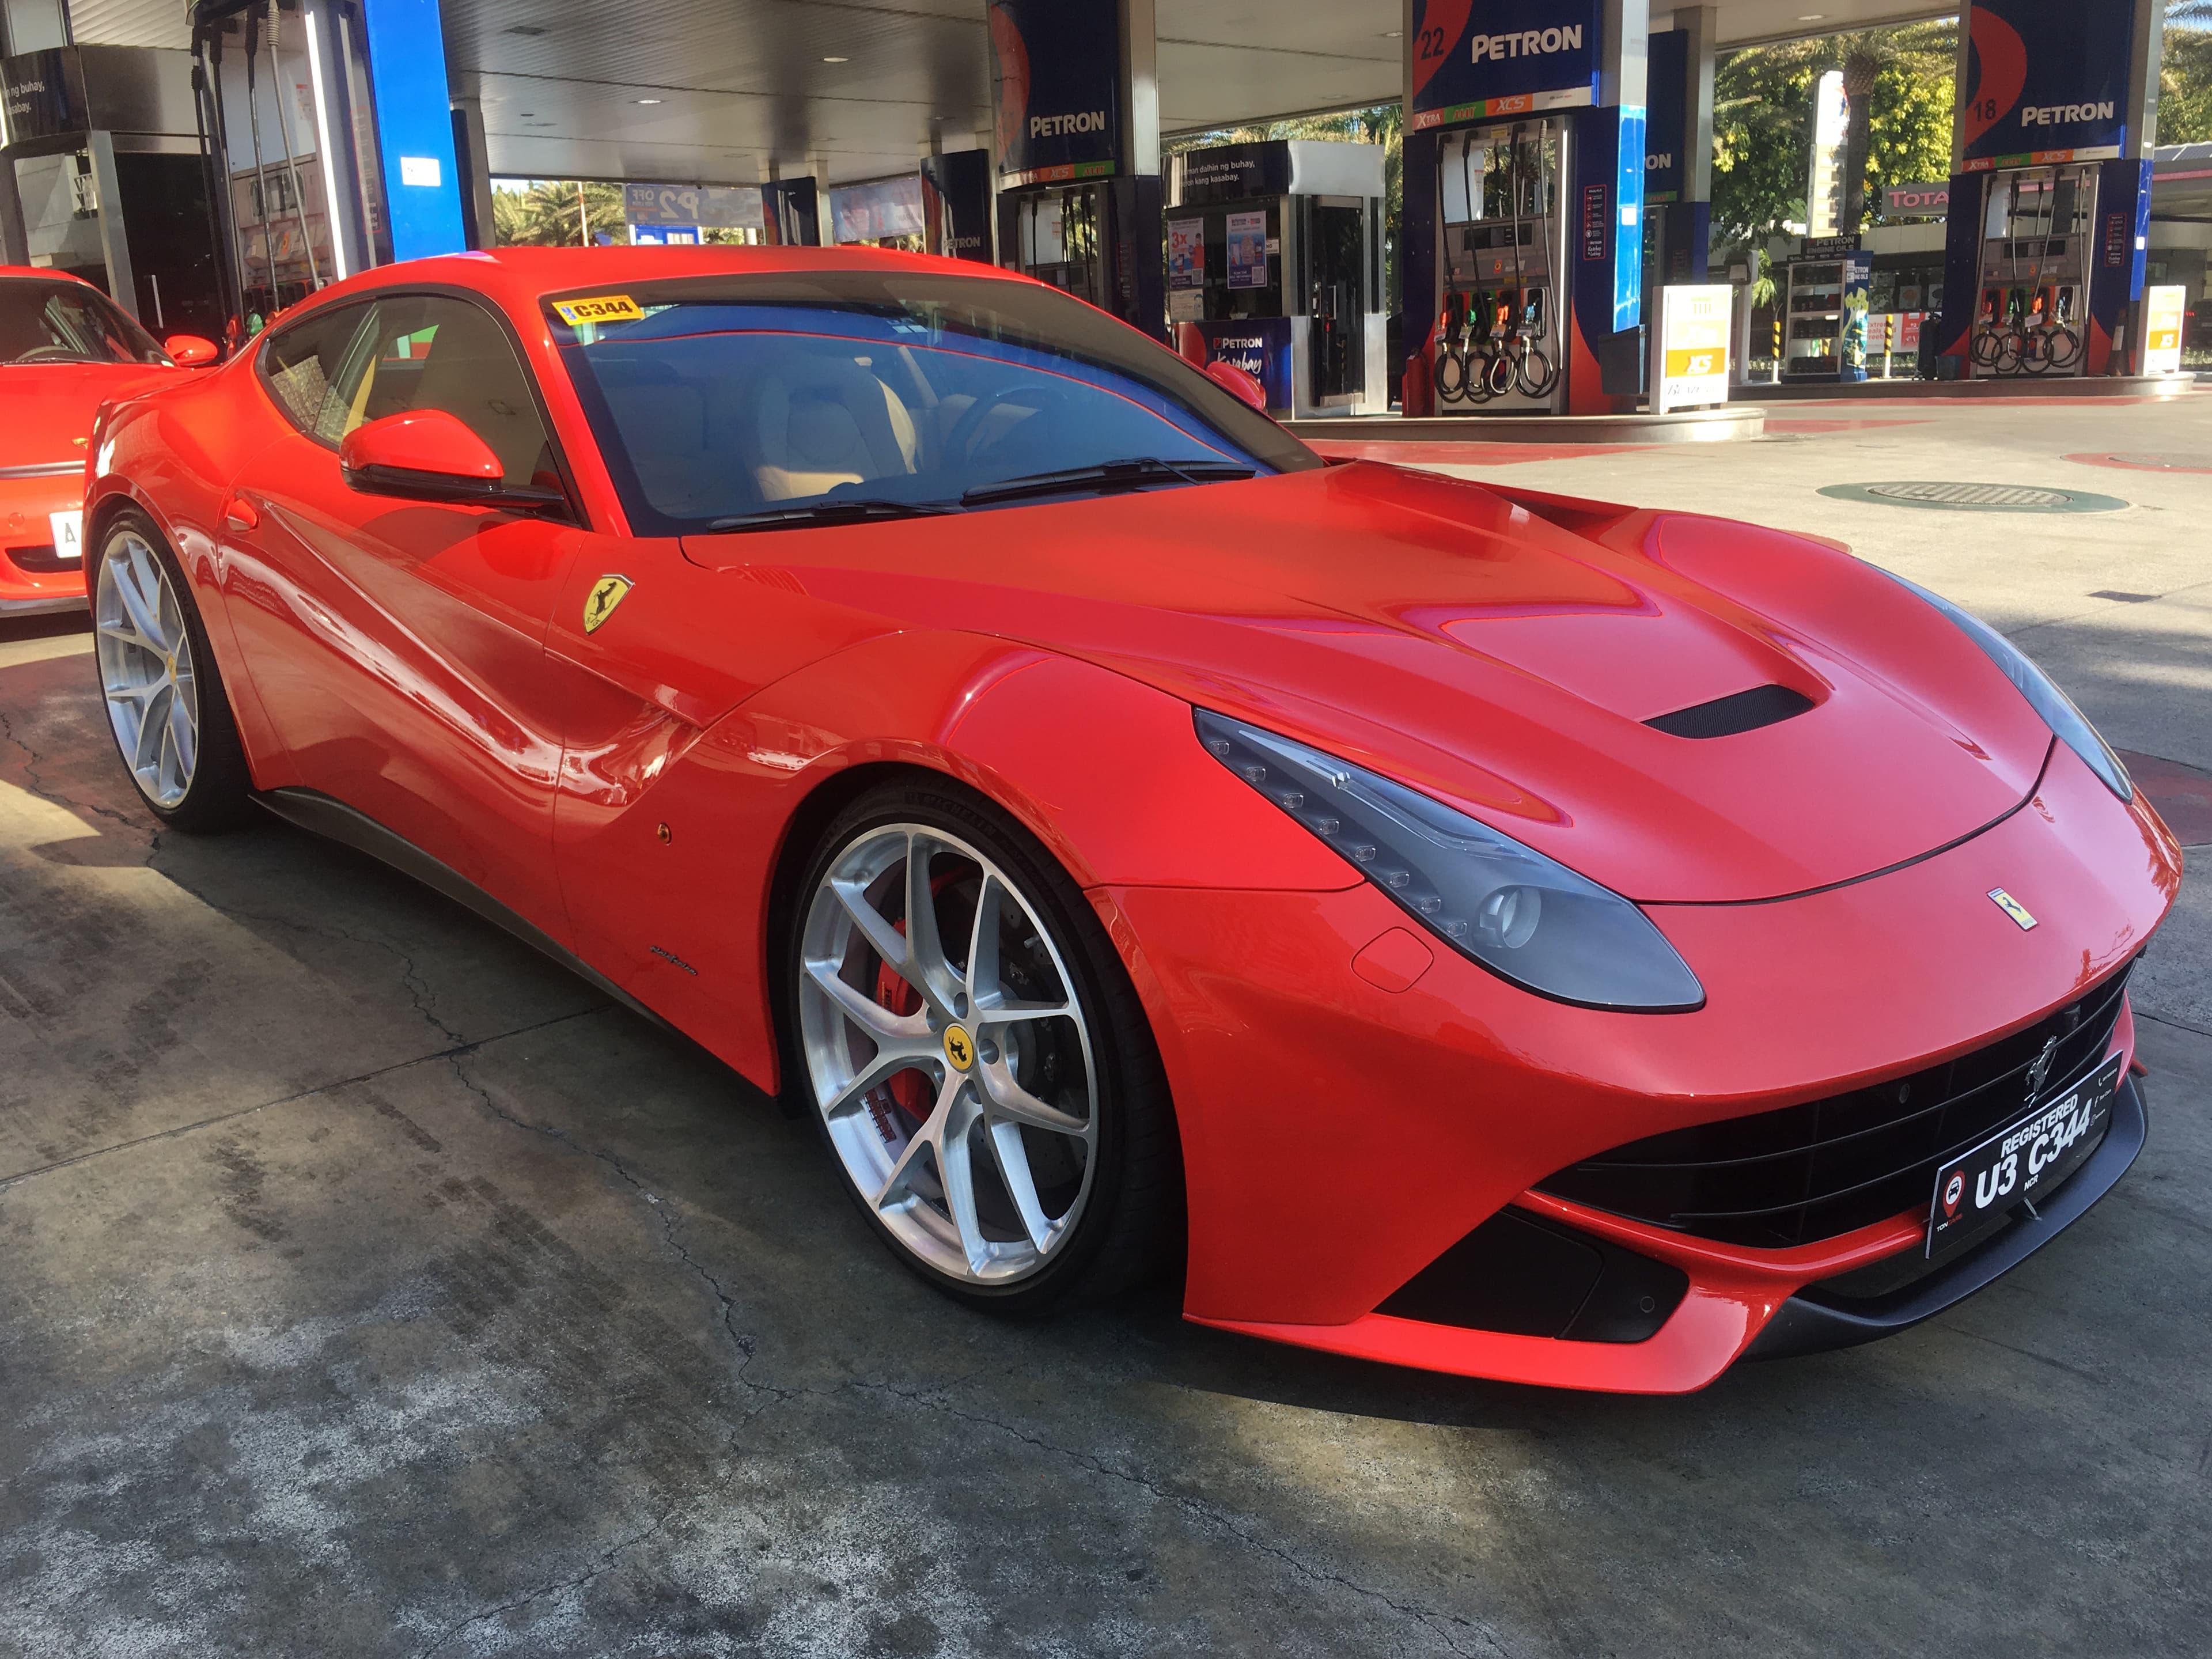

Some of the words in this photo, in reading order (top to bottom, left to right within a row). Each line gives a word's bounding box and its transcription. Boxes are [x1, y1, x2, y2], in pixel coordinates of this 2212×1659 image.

[1421, 27, 1444, 60] 22
[1472, 24, 1582, 63] PETRON
[11, 86, 20, 97] ng
[20, 81, 45, 94] buhay,
[1496, 97, 1526, 111] XCS
[1974, 99, 1996, 122] 18
[1418, 113, 1440, 128] XTRA
[2022, 101, 2114, 127] PETRON
[1030, 111, 1105, 139] PETRON
[2041, 151, 2067, 162] XCS
[1050, 166, 1069, 179] XCS
[1220, 163, 1229, 171] ng
[1230, 160, 1255, 169] buhay,
[1210, 174, 1239, 183] kasabay.
[1888, 191, 1949, 207] TOTA
[1816, 236, 1854, 246] PETRON
[574, 301, 633, 316] C344
[1222, 338, 1263, 349] PETRON
[2001, 1094, 2078, 1158] REGISTERED
[1975, 1153, 2018, 1209] U3
[2028, 1098, 2092, 1175] C344
[2024, 1175, 2039, 1191] NCR
